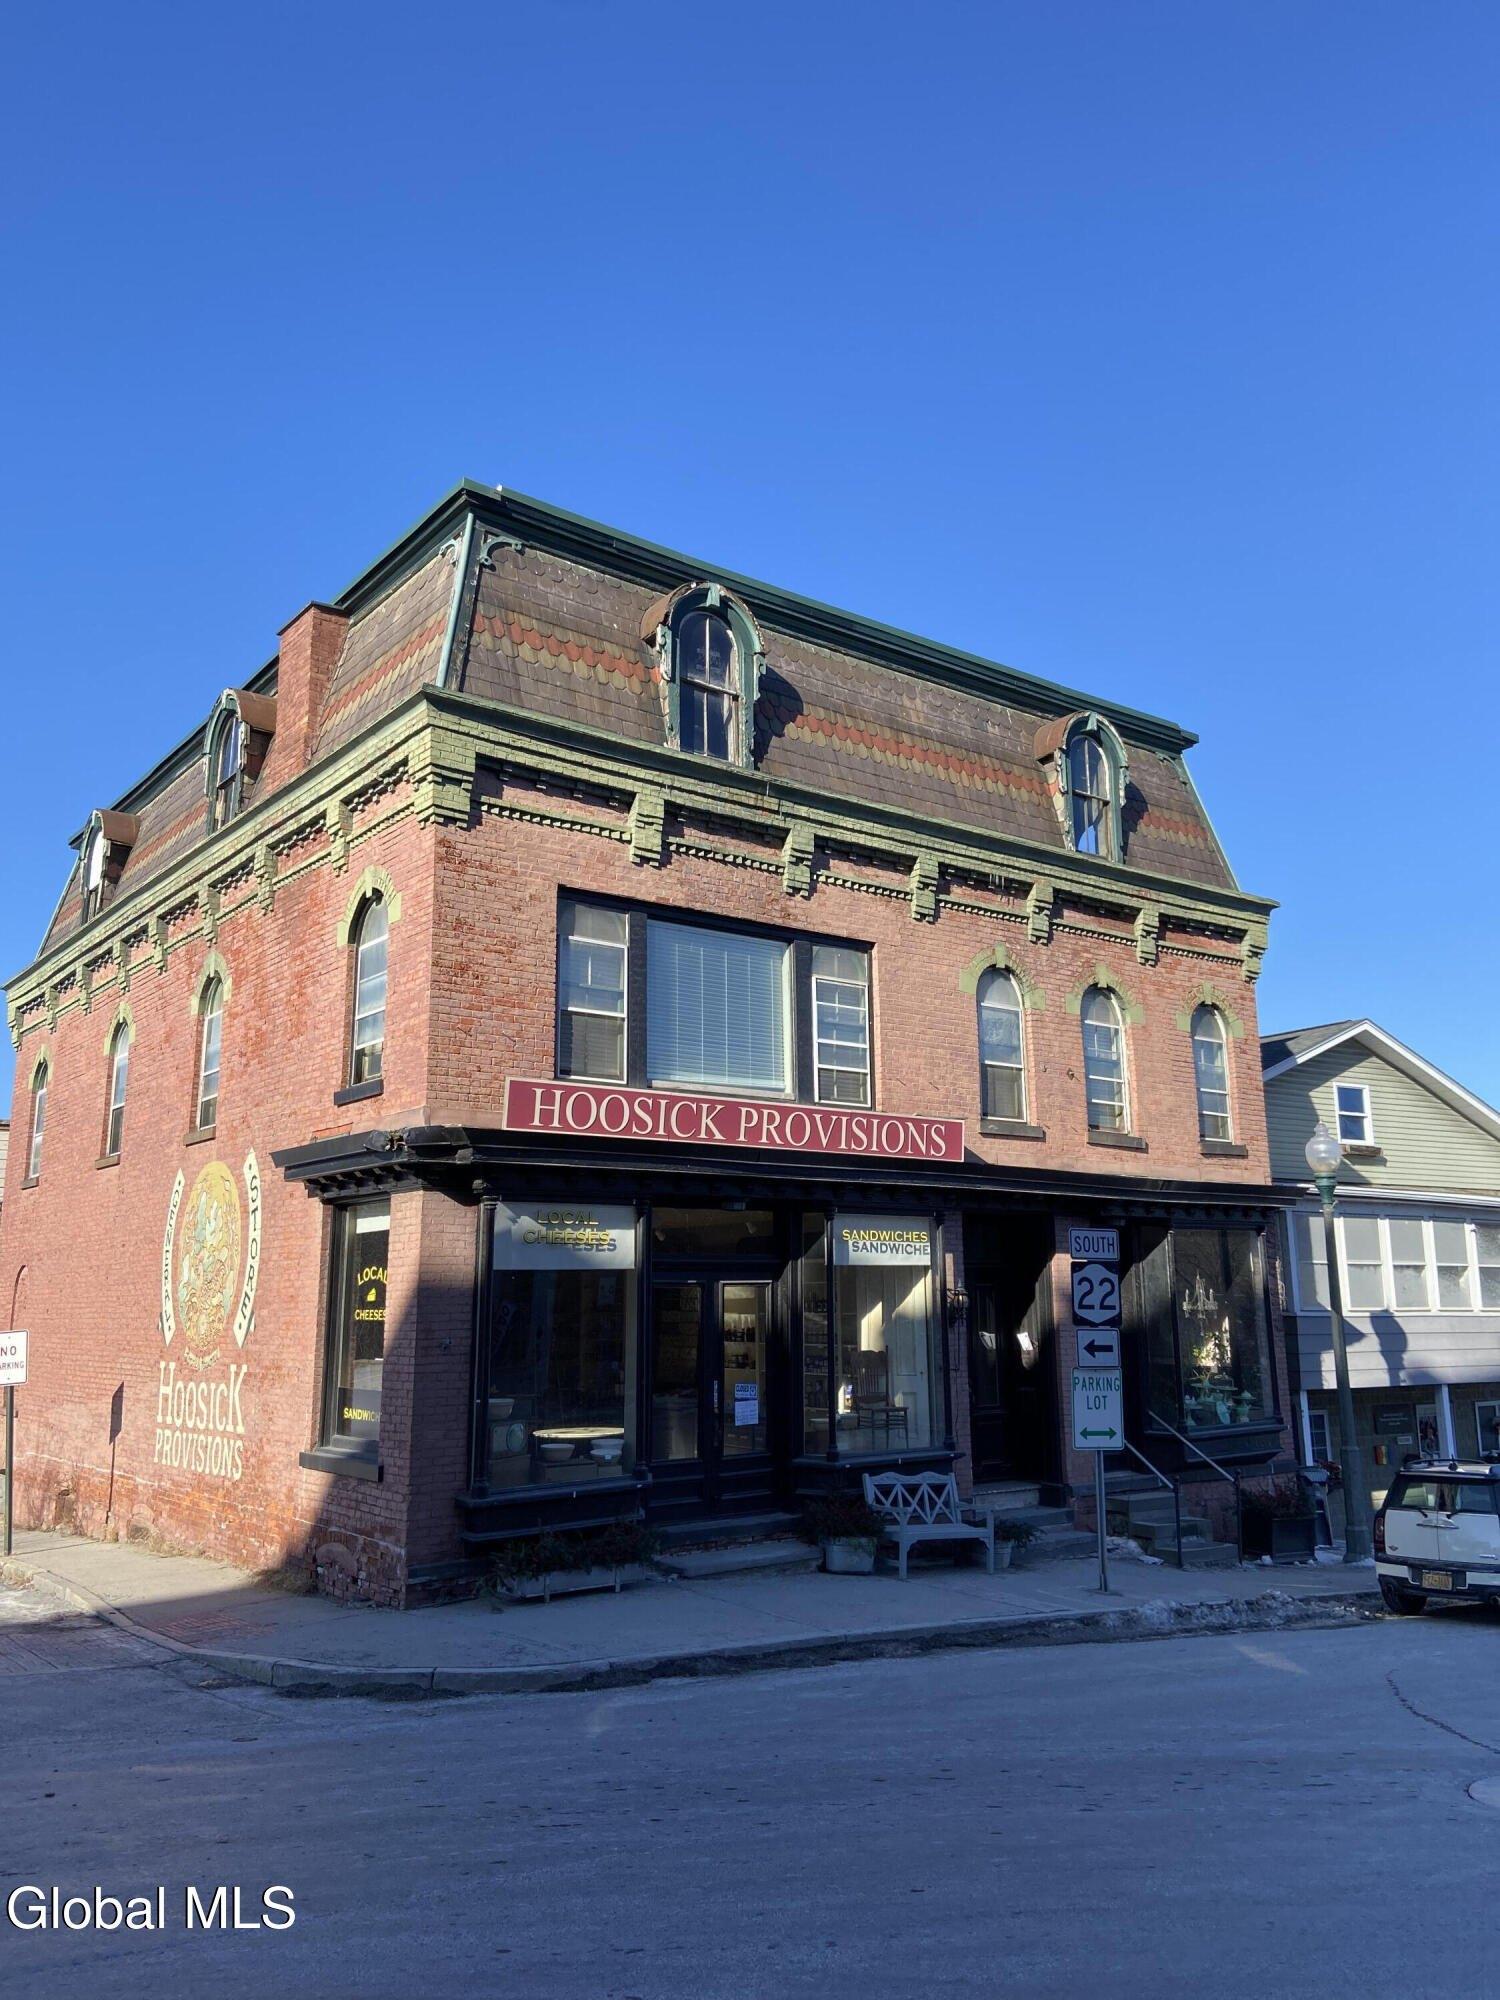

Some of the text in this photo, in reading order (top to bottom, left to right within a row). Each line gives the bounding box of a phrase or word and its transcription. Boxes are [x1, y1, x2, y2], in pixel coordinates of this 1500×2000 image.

[529, 1086, 947, 1157] HOOSICK PROVISIONS
[535, 1208, 599, 1225] LOCAL
[522, 1230, 610, 1245] CHEESES
[842, 1229, 928, 1242] SANDWICHES
[1074, 1235, 1115, 1253] SOUTH
[163, 1189, 181, 1323] GENERAL
[240, 1174, 260, 1320] STORE
[357, 1266, 388, 1286] LOCAL
[1077, 1276, 1117, 1310] 22
[0, 1345, 17, 1357] NO
[1073, 1376, 1120, 1391] PARKING
[156, 1361, 248, 1434] HOOSICK
[1086, 1395, 1108, 1410] LOT
[153, 1428, 243, 1480] PROVISIONS
